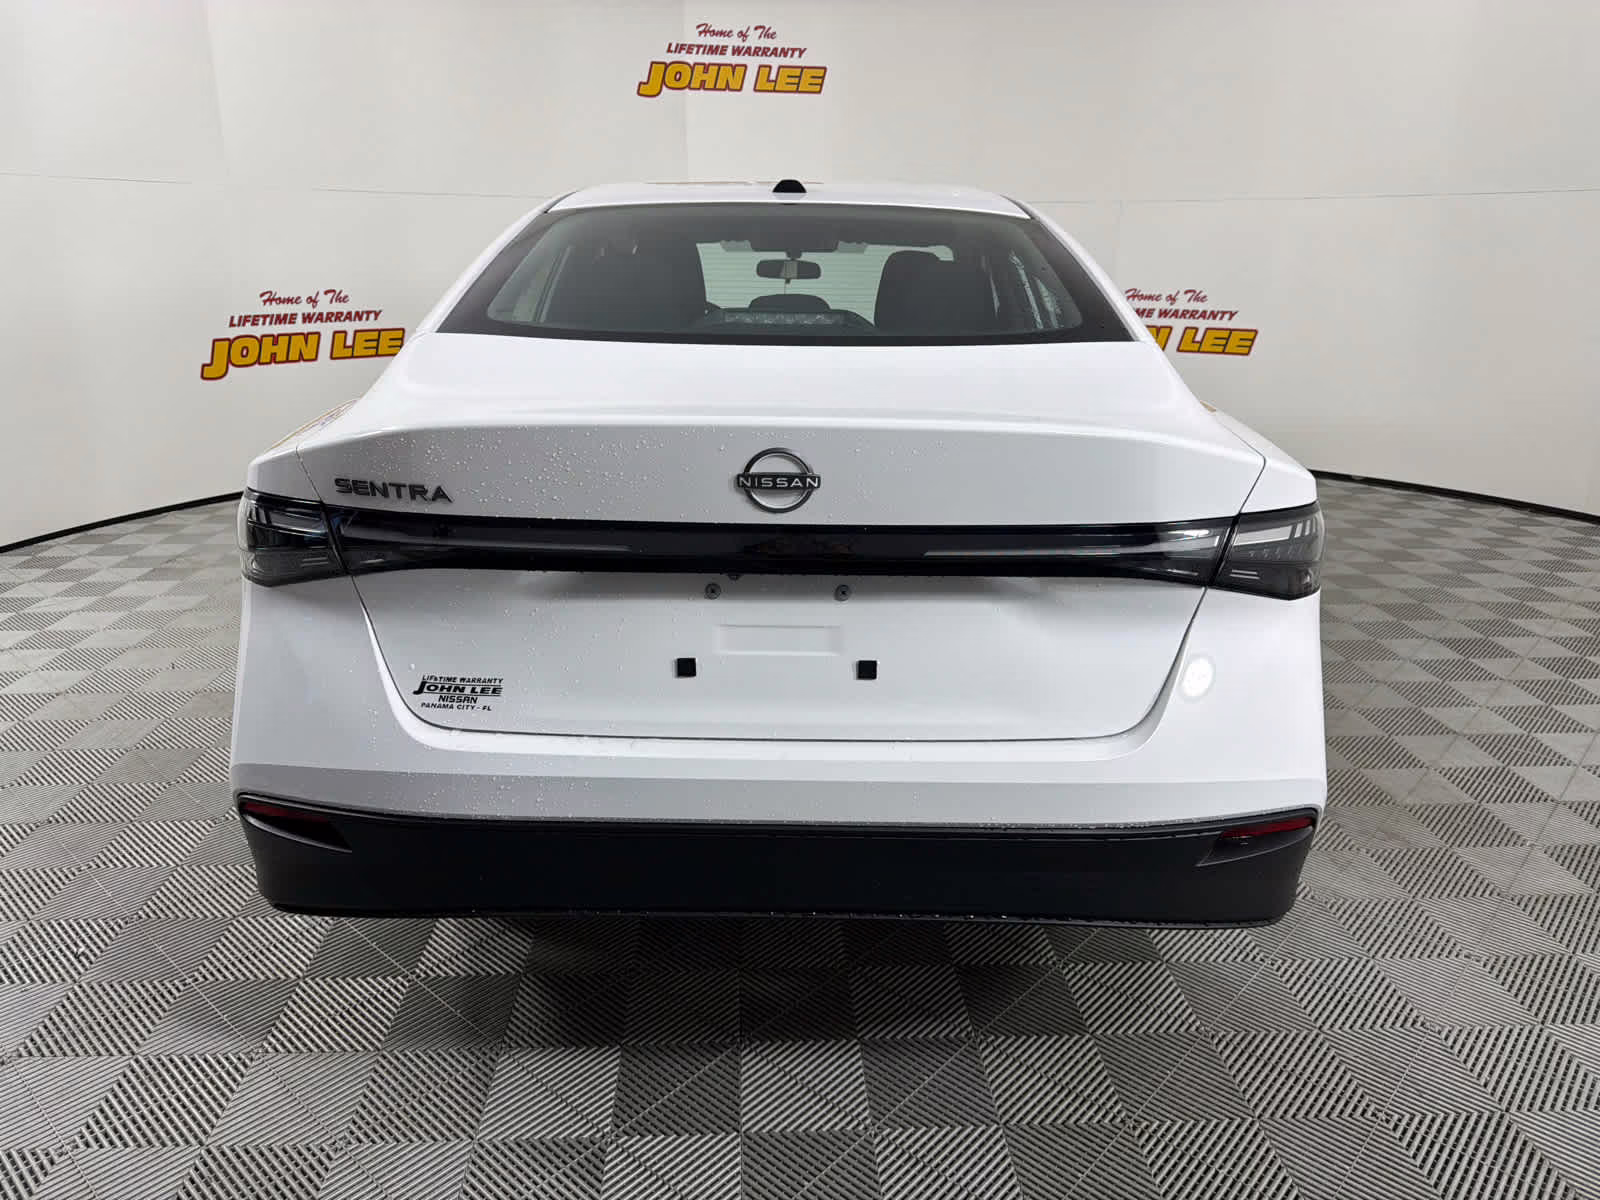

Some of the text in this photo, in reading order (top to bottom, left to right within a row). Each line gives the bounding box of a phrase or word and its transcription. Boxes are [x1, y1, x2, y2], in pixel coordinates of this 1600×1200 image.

[696, 22, 777, 42] Home of The
[666, 42, 807, 59] LIFETIME WARRANTY
[636, 60, 827, 98] JOHN LEE
[258, 288, 350, 309] Home of The
[1124, 287, 1209, 306] Home of The
[228, 309, 382, 328] LIFETIME WARRANTY
[1158, 308, 1240, 322] WARRANTY
[1176, 326, 1258, 356] LEE
[200, 328, 406, 380] JOHN LEE
[334, 478, 453, 504] SENTRA
[738, 476, 819, 488] NISSAN
[412, 680, 503, 696] JOHN LEE
[422, 674, 458, 683] LIFETIME
[438, 694, 478, 704] NISSAN
